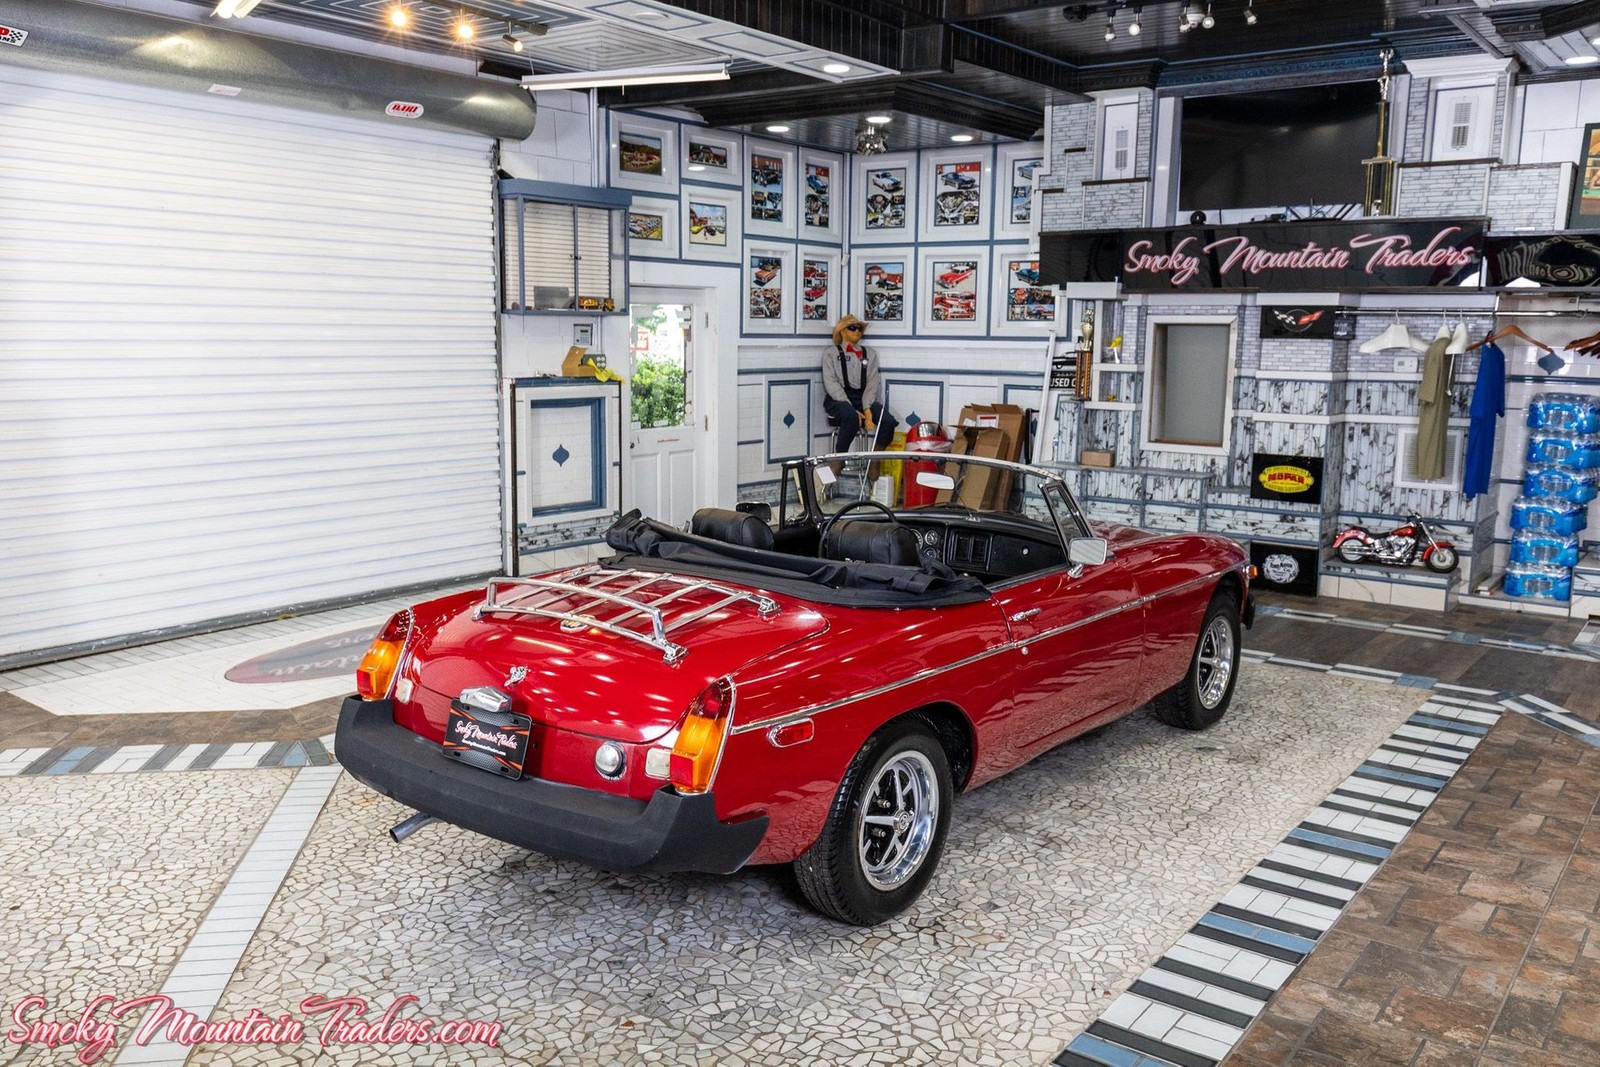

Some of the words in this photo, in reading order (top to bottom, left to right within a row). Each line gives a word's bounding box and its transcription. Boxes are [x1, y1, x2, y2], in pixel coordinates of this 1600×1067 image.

[1124, 236, 1199, 285] Smoky
[1203, 235, 1349, 275] Mountain
[1350, 226, 1475, 274] Traders
